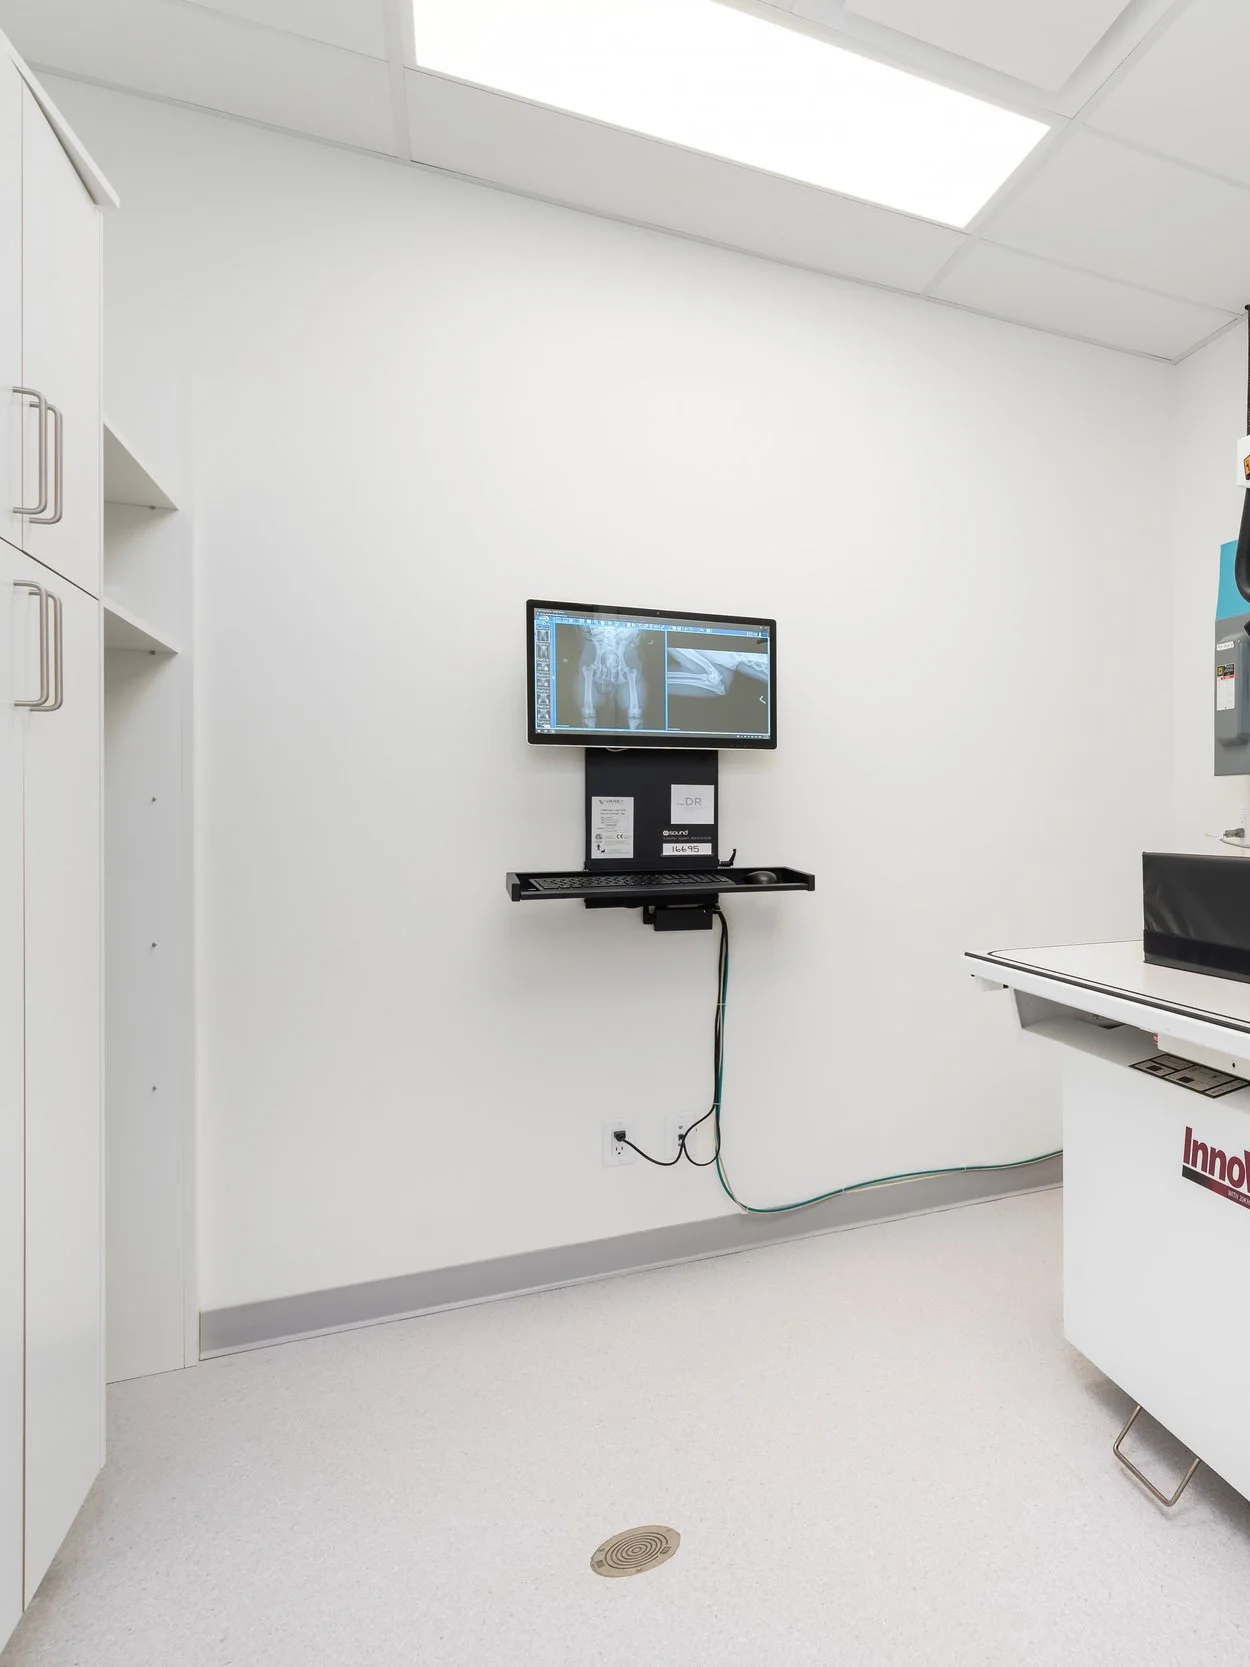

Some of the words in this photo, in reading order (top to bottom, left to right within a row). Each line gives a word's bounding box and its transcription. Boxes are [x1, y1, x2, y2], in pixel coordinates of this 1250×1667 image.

[685, 797, 702, 806] DR
[672, 845, 700, 853] 16695
[1227, 1189, 1239, 1201] WITH
